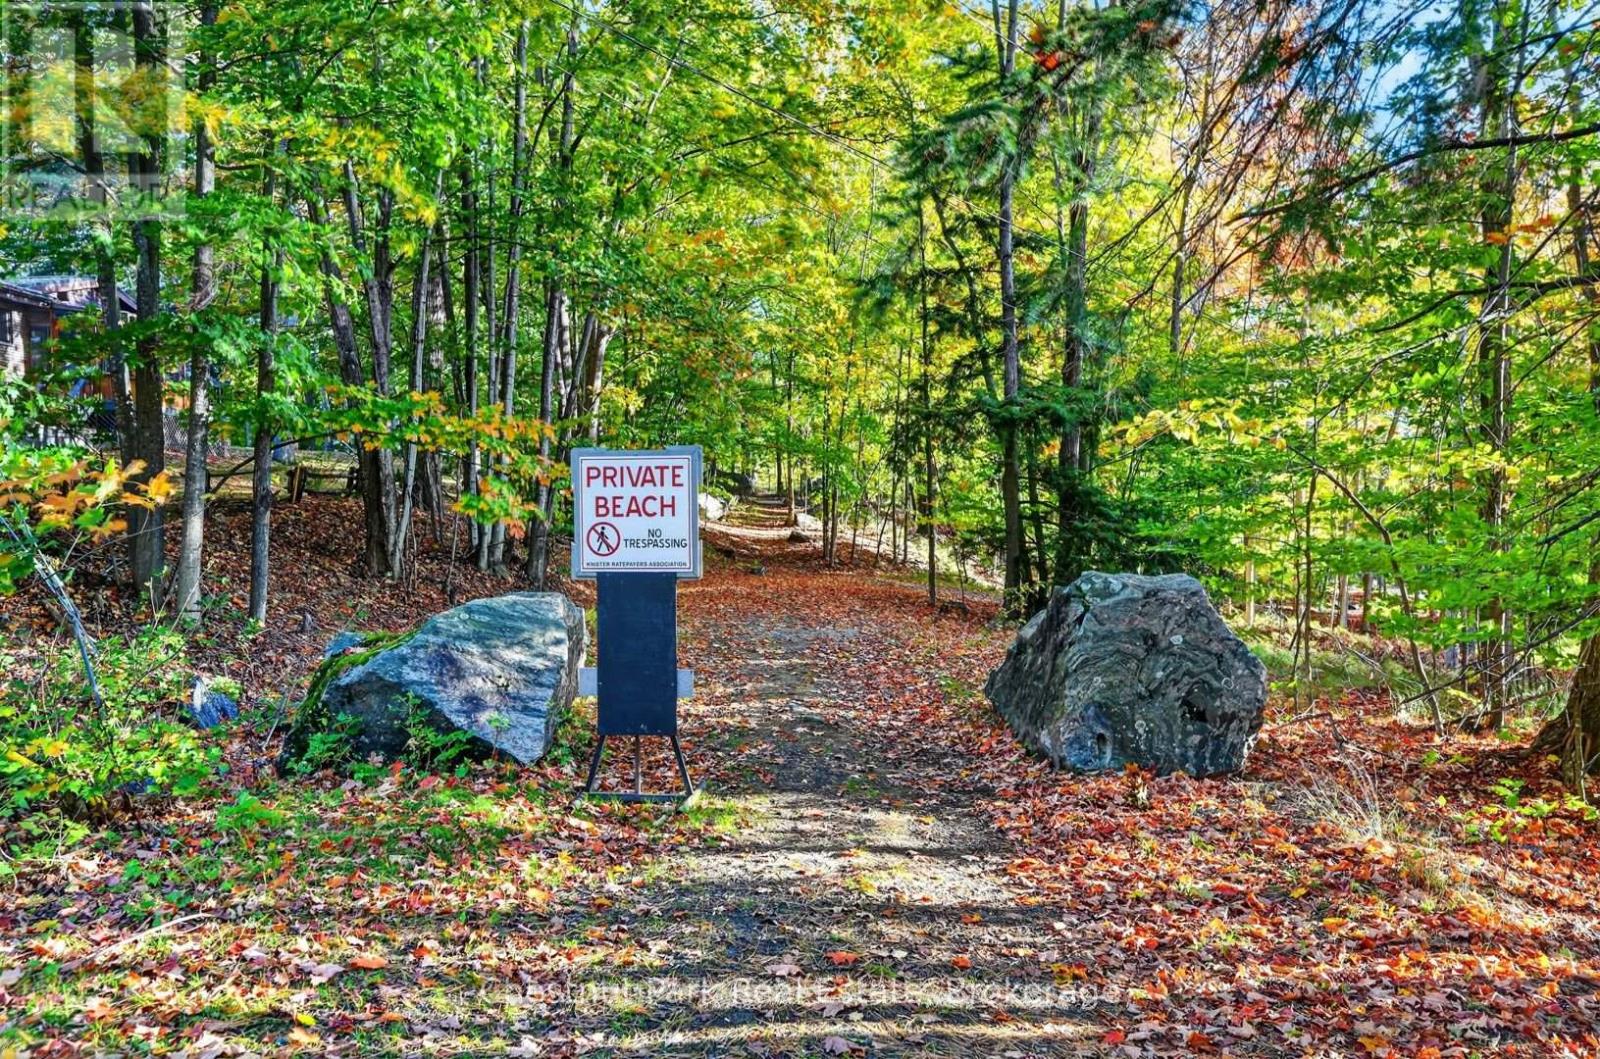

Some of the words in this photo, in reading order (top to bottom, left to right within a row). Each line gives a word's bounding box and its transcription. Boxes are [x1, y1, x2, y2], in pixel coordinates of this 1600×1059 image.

[586, 465, 684, 488] PRIVATE
[595, 495, 676, 518] BEACH
[648, 528, 662, 538] NO
[624, 538, 688, 549] TRESPASSING
